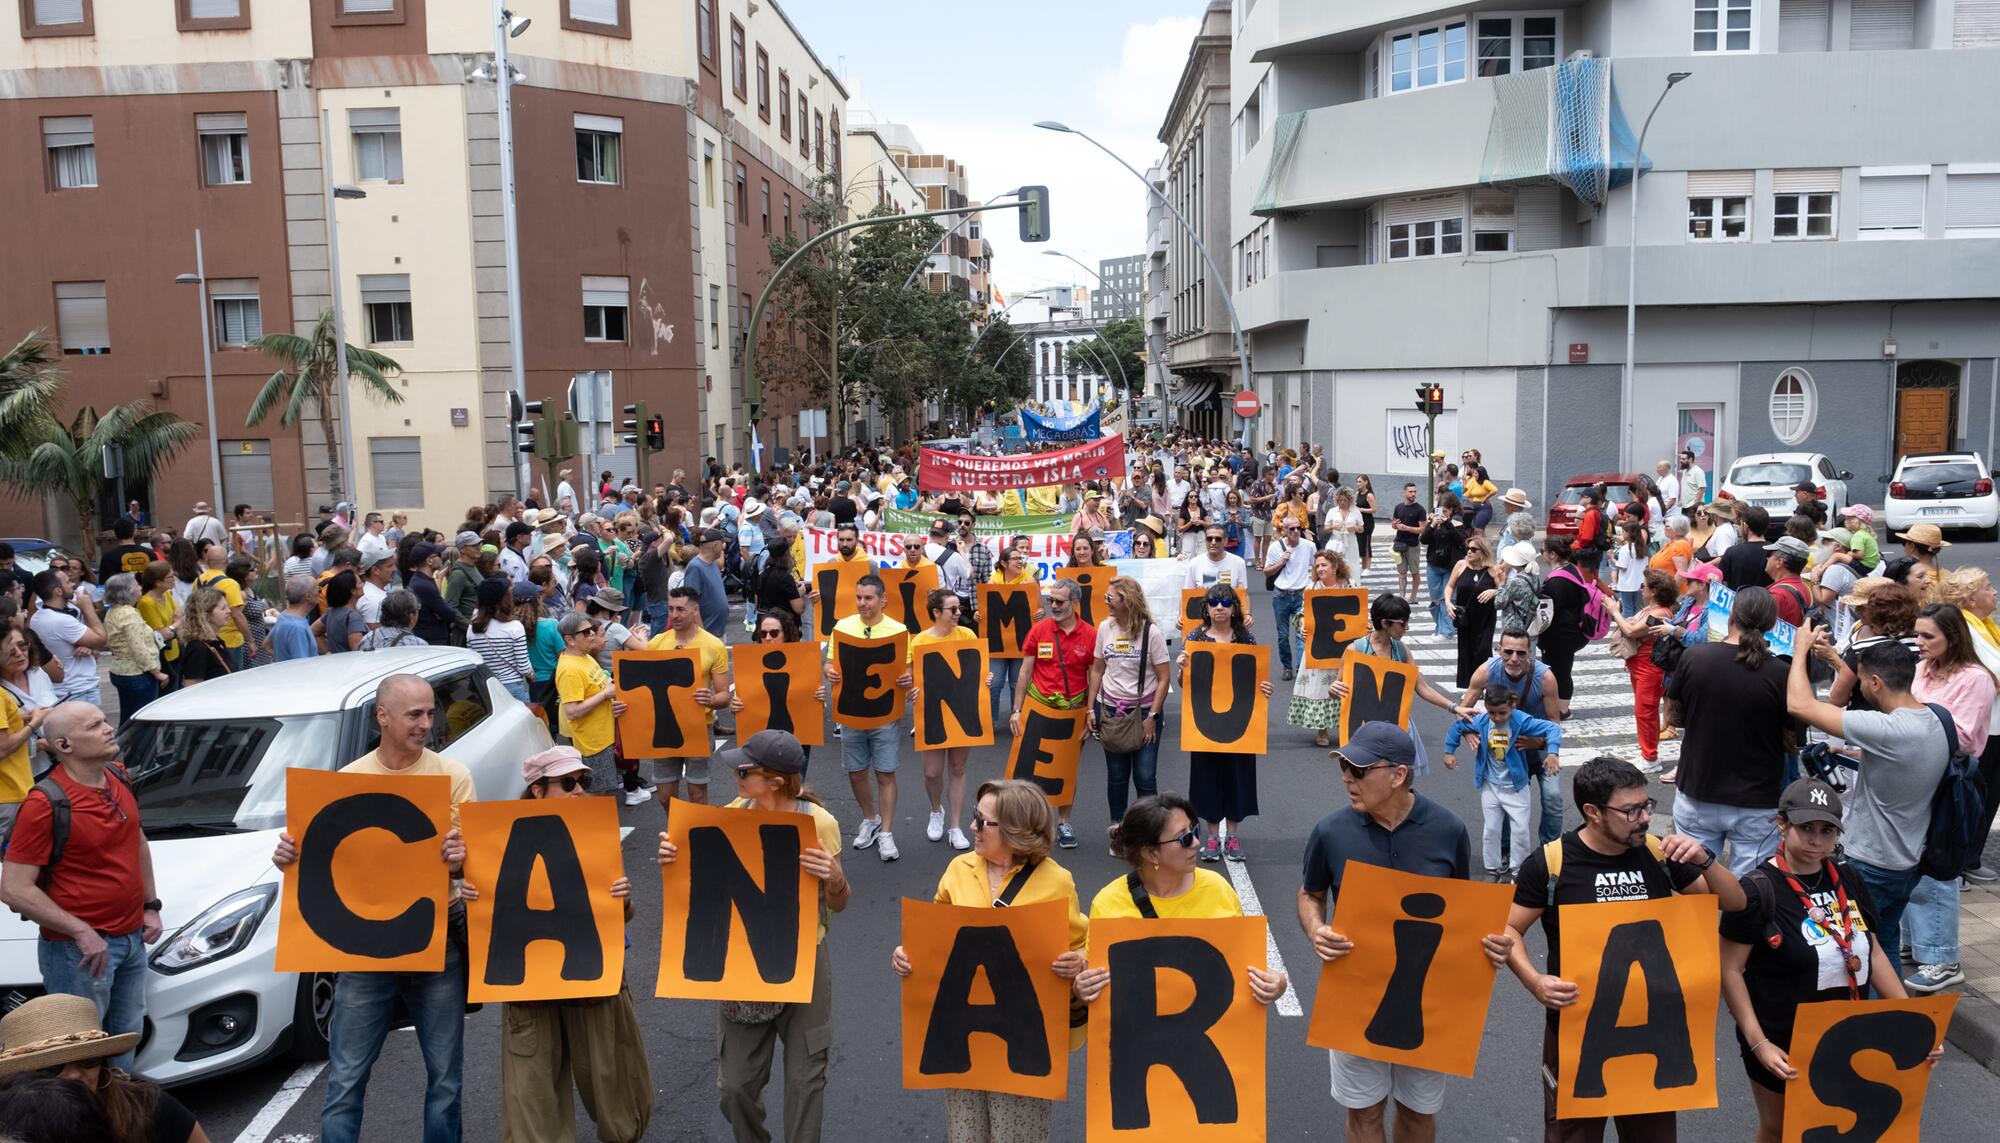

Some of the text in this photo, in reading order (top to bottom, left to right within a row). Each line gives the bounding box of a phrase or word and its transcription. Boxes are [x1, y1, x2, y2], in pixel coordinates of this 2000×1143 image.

[932, 445, 1106, 471] NO QUEREMOS VER MORIR
[1032, 424, 1096, 441] MEGAOBRAS
[1041, 420, 1055, 429] NO
[951, 464, 1083, 486] NUESTRA ISLA
[986, 590, 1032, 653] M
[1311, 595, 1361, 660] E
[618, 657, 696, 749] T
[837, 642, 896, 719] E
[922, 648, 983, 746] N
[1190, 650, 1257, 744] U
[1348, 662, 1406, 741] N
[1013, 709, 1076, 796] E
[298, 792, 438, 959] C
[484, 814, 603, 986] A
[682, 823, 801, 985] N
[1595, 870, 1645, 887] ATAN
[920, 925, 1052, 1077] A
[1108, 935, 1238, 1130] R
[1573, 919, 1698, 1099] A
[1801, 1009, 1938, 1143] S
